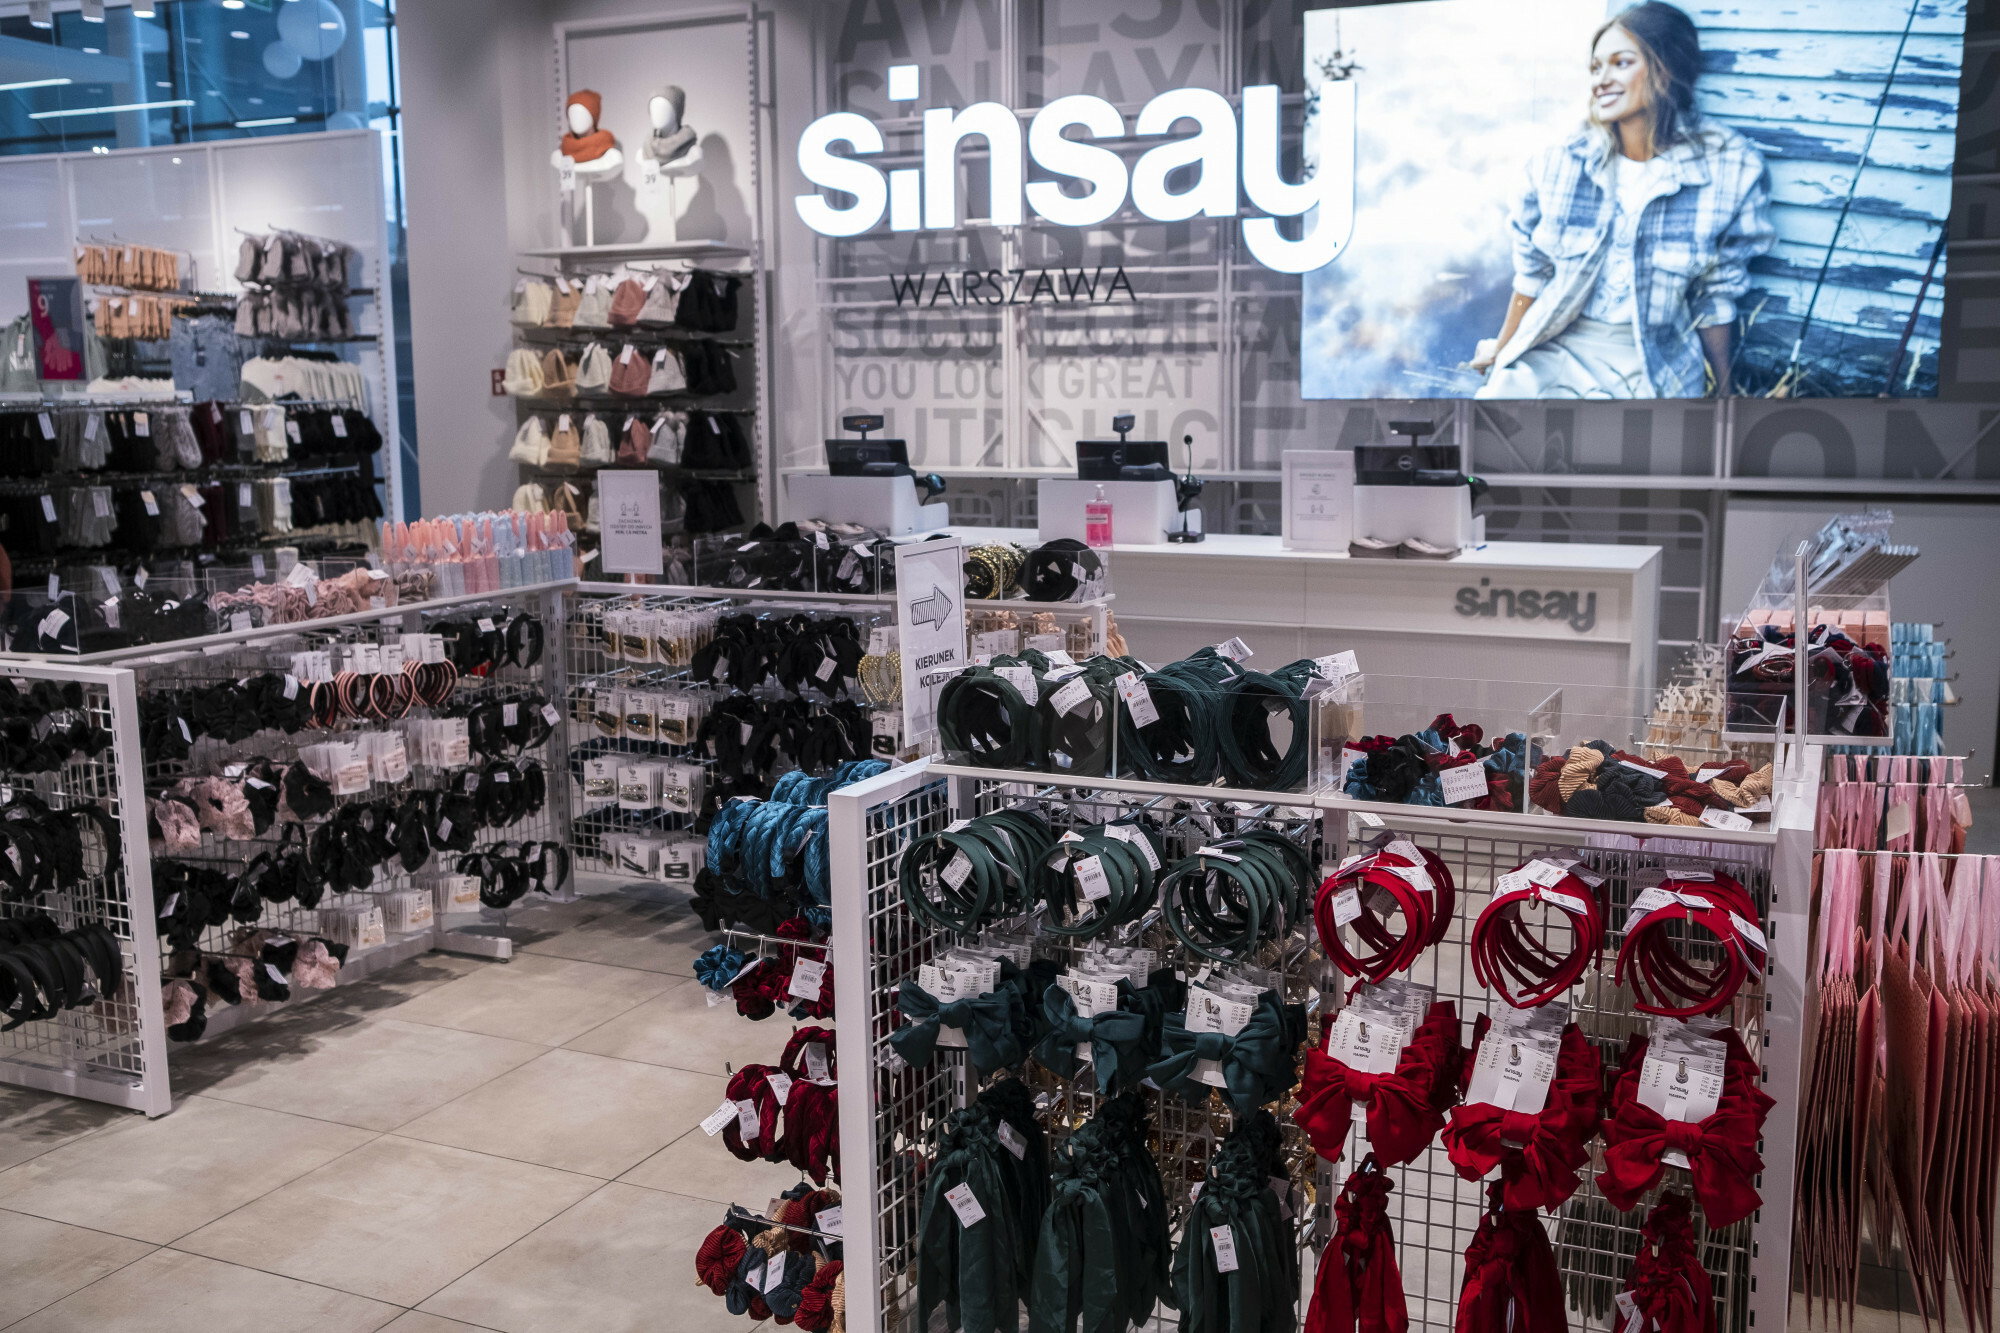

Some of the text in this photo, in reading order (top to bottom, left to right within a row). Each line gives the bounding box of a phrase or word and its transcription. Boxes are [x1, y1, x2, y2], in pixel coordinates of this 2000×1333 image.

[645, 173, 657, 184] 39
[794, 64, 1356, 274] sinsay
[889, 265, 1138, 308] WARSZAWA
[834, 359, 1203, 401] YOU LOOK GREAT
[1454, 577, 1597, 632] sinsay
[915, 648, 955, 671] KIERUNEK
[1353, 1045, 1371, 1054] sinsay
[1504, 1067, 1523, 1078] sinsay
[1669, 1084, 1689, 1096] sinsay
